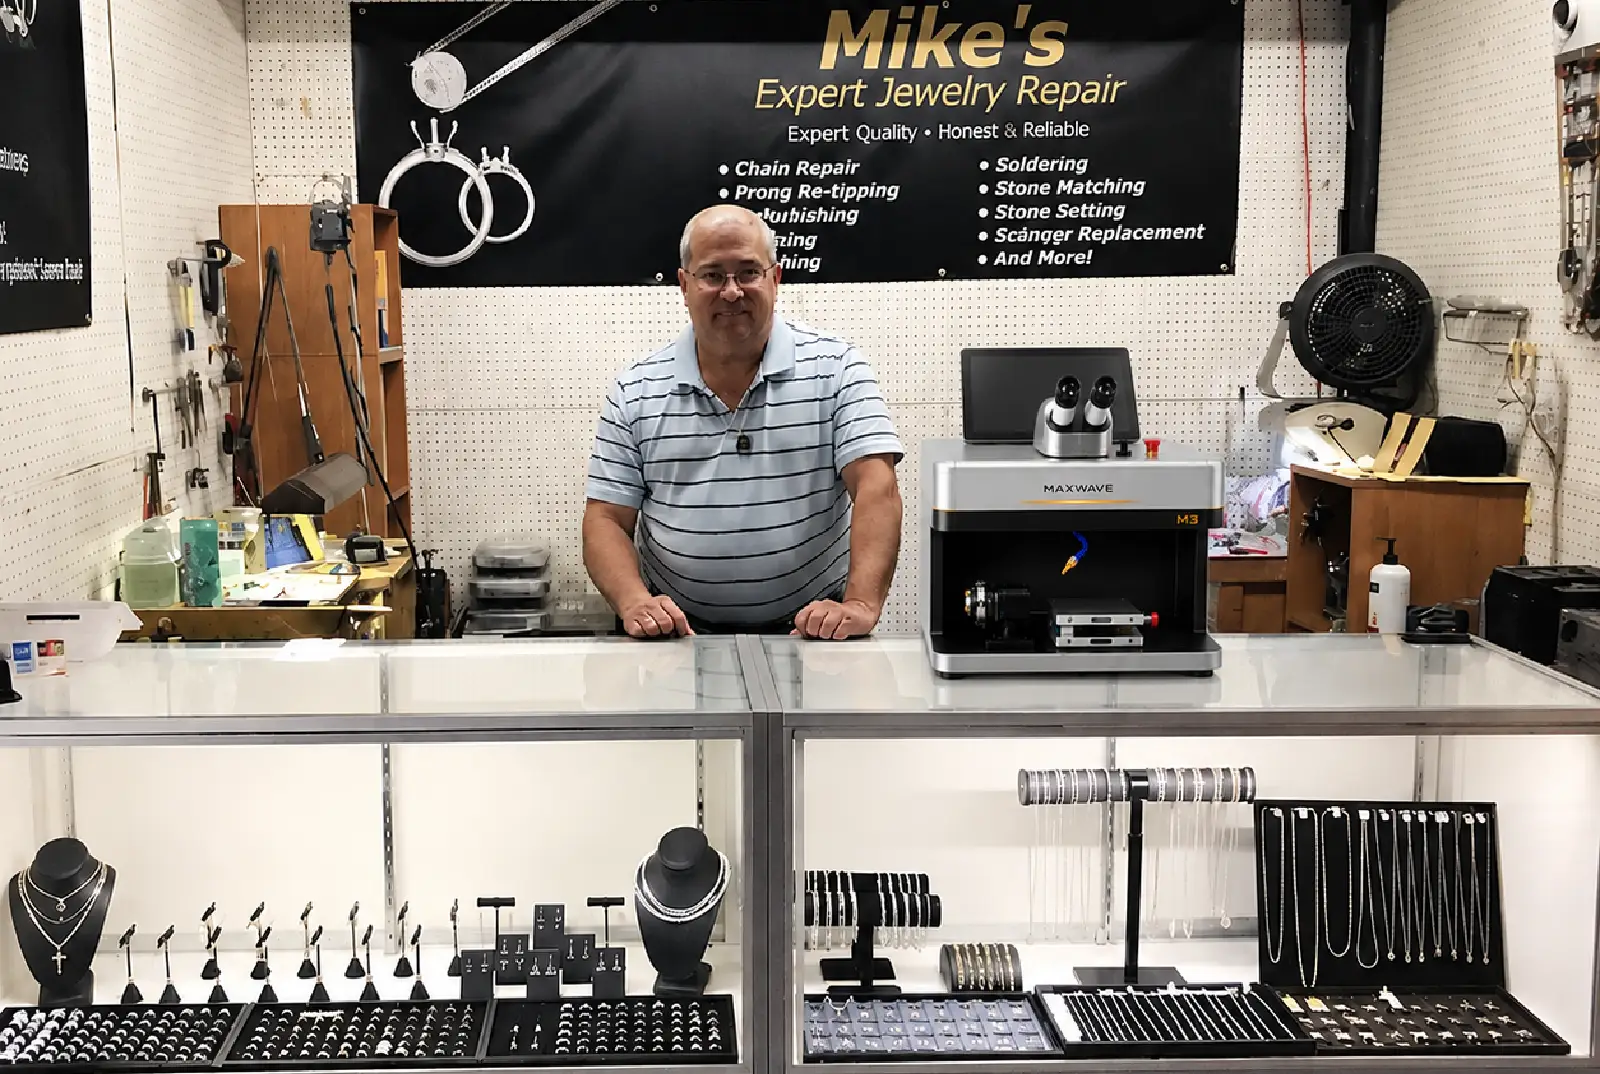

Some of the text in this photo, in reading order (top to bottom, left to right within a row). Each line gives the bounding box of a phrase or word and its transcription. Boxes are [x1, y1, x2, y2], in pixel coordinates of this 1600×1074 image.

[819, 5, 1068, 70] Mike's
[755, 74, 1127, 115] Expert Jewelry Repair
[788, 121, 1090, 145] Expert Quality Honest & Reliable
[735, 159, 860, 179] Chain Repair
[995, 156, 1088, 175] Soldering
[735, 181, 900, 203] Prong Re-tipping
[995, 177, 1146, 197] Stone Matching
[995, 203, 1125, 221] Stone Setting
[1078, 223, 1206, 244] Replacement
[994, 249, 1093, 266] And More!
[1043, 484, 1114, 493] MAXWAVE
[1176, 513, 1199, 525] M3
